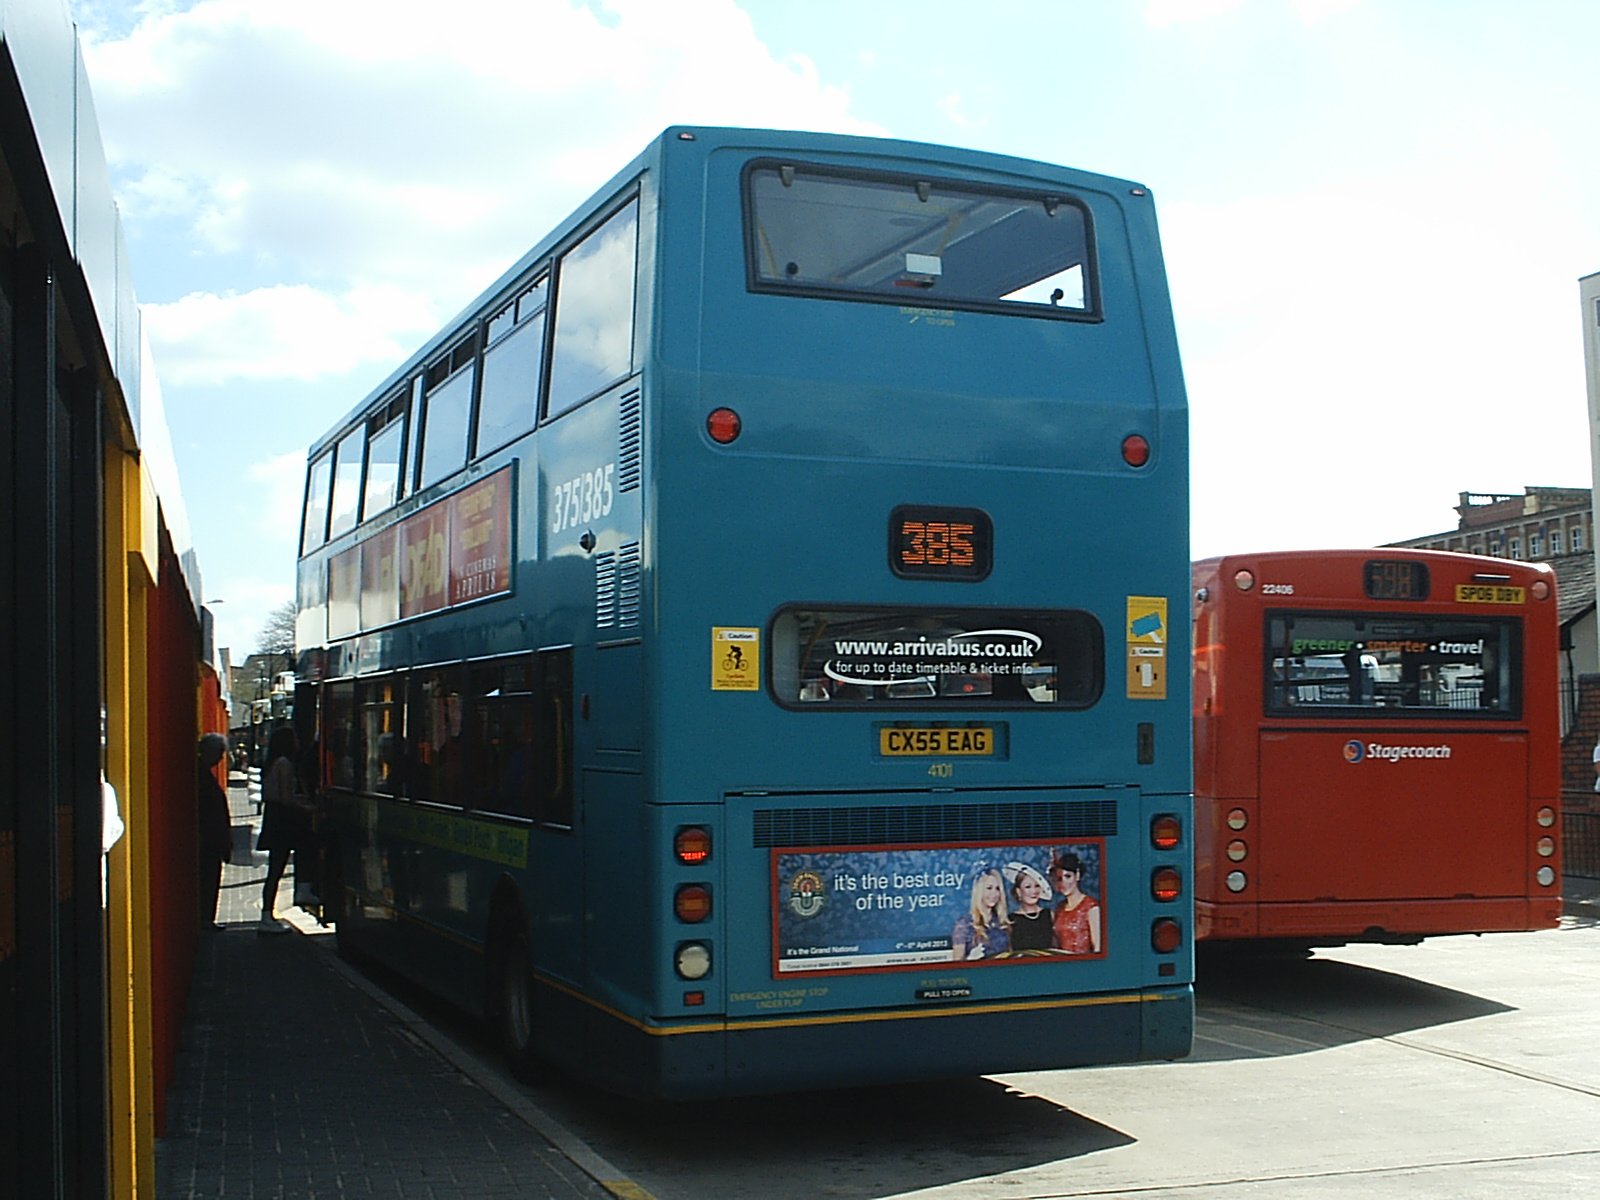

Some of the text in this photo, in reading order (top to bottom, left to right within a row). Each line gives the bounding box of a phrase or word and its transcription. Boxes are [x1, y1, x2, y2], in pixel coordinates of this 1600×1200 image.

[552, 463, 614, 534] 375/385
[901, 521, 974, 566] 385
[466, 555, 497, 577] CINEMAS
[456, 573, 483, 600] APRIL
[1460, 585, 1493, 601] SP06
[834, 636, 1034, 657] www.arrivabus.co.uk
[1292, 638, 1484, 655] greener smarter travel
[836, 661, 1034, 676] for up to date timetable & ticket info
[888, 731, 986, 752] CX55 EAG
[1366, 743, 1451, 763] Stagecoach
[928, 763, 953, 778] 4101
[834, 873, 857, 891] it's
[862, 873, 888, 891] the
[893, 871, 930, 889] best
[934, 870, 965, 890] day
[855, 893, 945, 912] of the year
[798, 947, 809, 956] the
[810, 945, 831, 955] Grand
[831, 945, 859, 954] National
[923, 988, 970, 998] PULL TO OPEN
